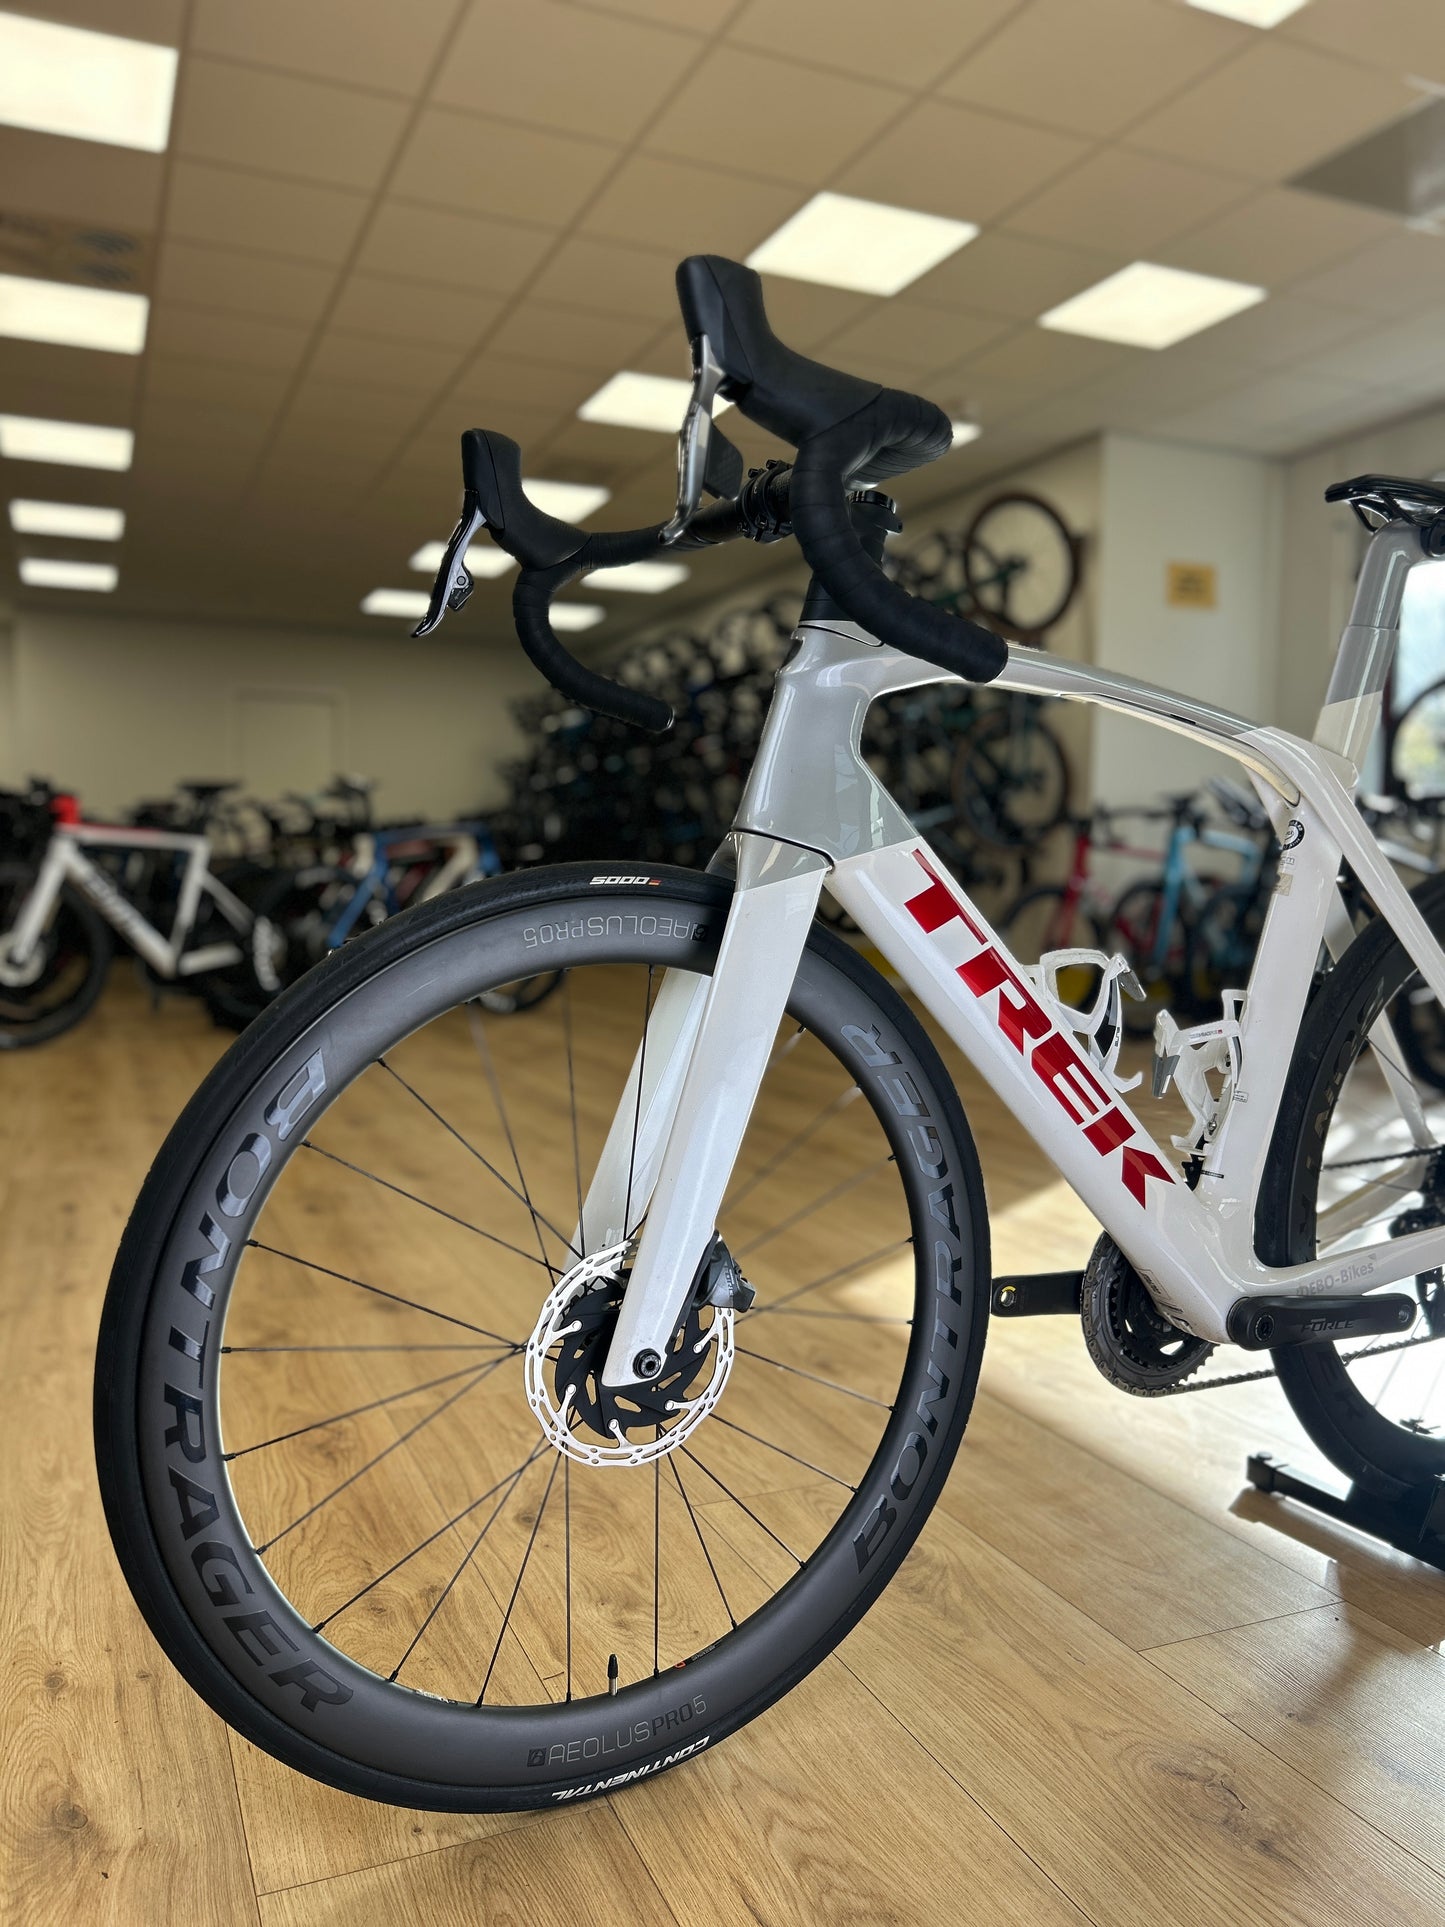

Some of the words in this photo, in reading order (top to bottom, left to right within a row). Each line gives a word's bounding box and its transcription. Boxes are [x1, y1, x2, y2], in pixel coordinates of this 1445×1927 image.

[589, 876, 649, 886] 5000
[904, 848, 1176, 1210] TREK
[164, 1047, 354, 1713] BONTRAGER
[840, 1024, 961, 1574] BONTRAGER
[1301, 1318, 1355, 1333] FORCE
[551, 1735, 710, 1801] CONTINENTAL
